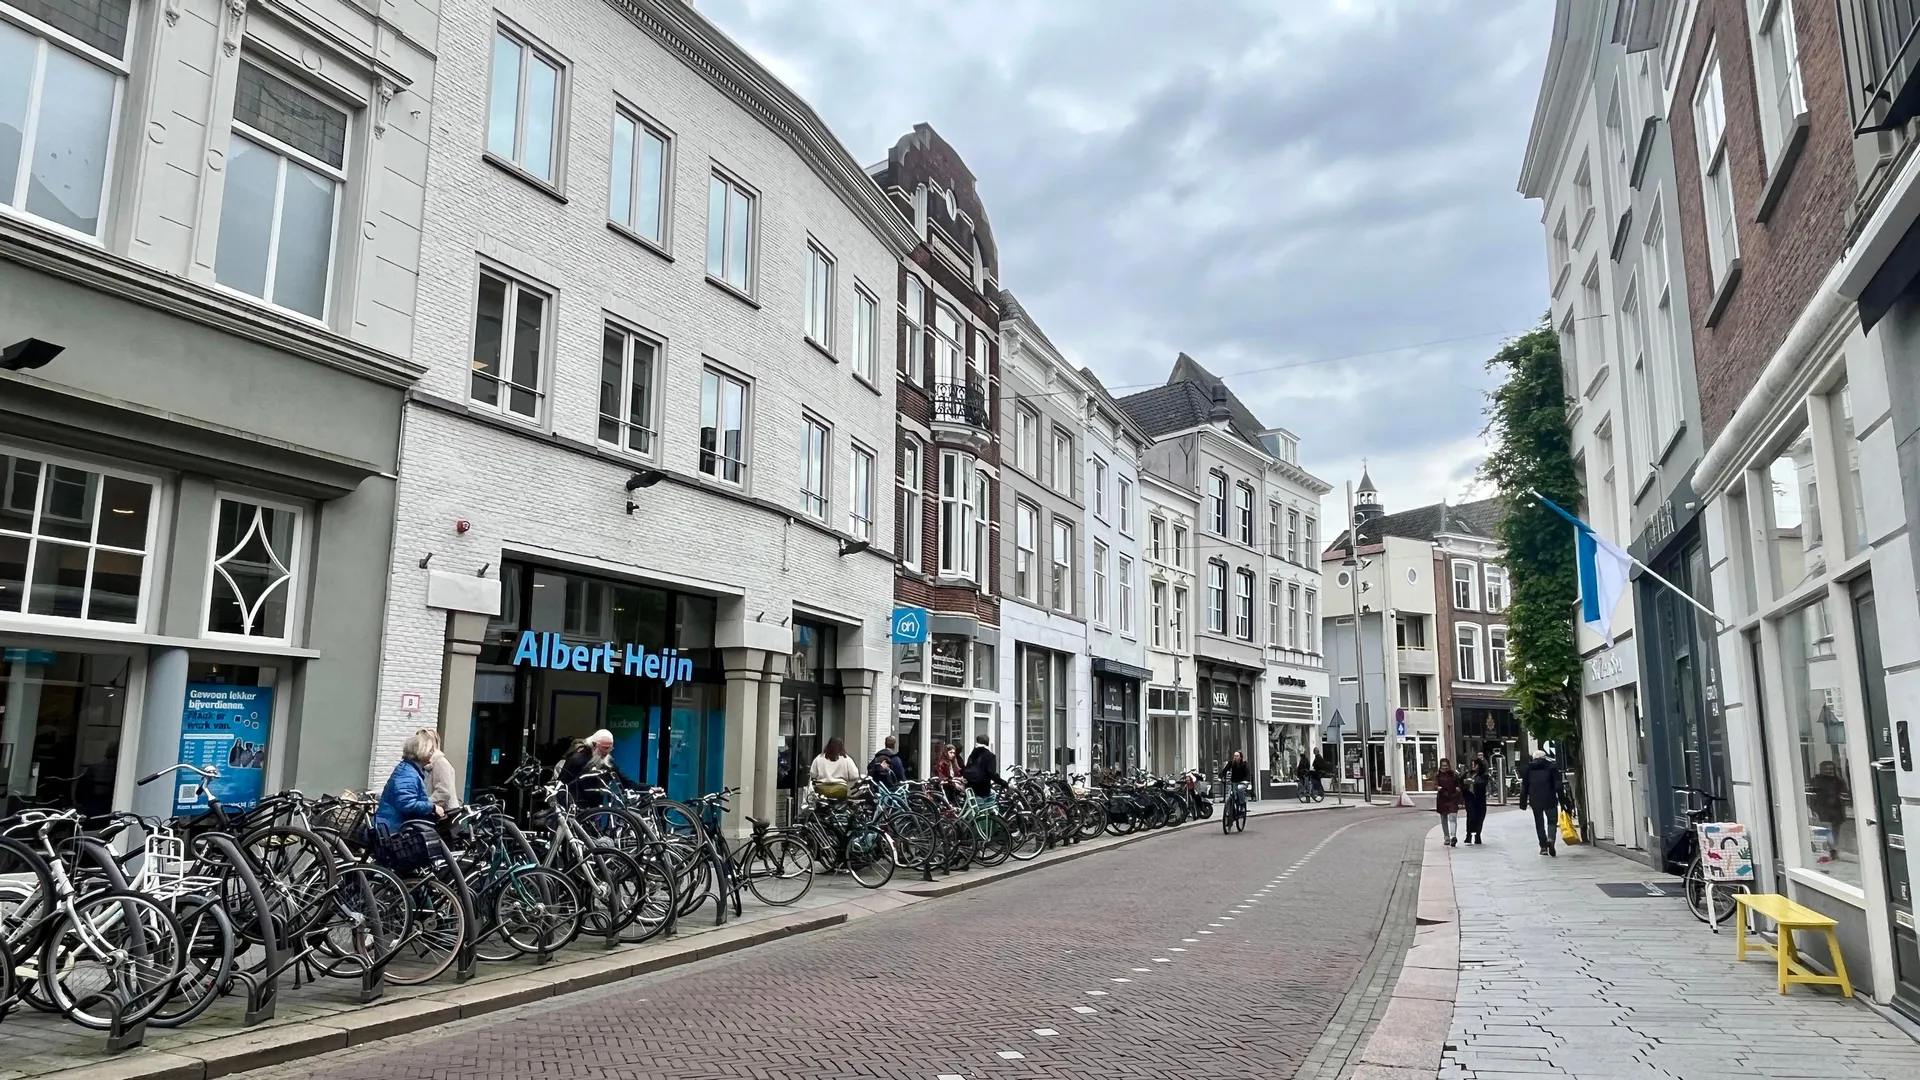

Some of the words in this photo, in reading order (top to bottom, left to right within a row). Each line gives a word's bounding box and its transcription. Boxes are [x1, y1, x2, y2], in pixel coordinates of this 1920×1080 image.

[513, 630, 615, 674] Albert
[624, 643, 693, 688] Heijn
[190, 690, 228, 700] Gewoon
[229, 691, 257, 701] lekker
[188, 699, 245, 711] bijverdienen.
